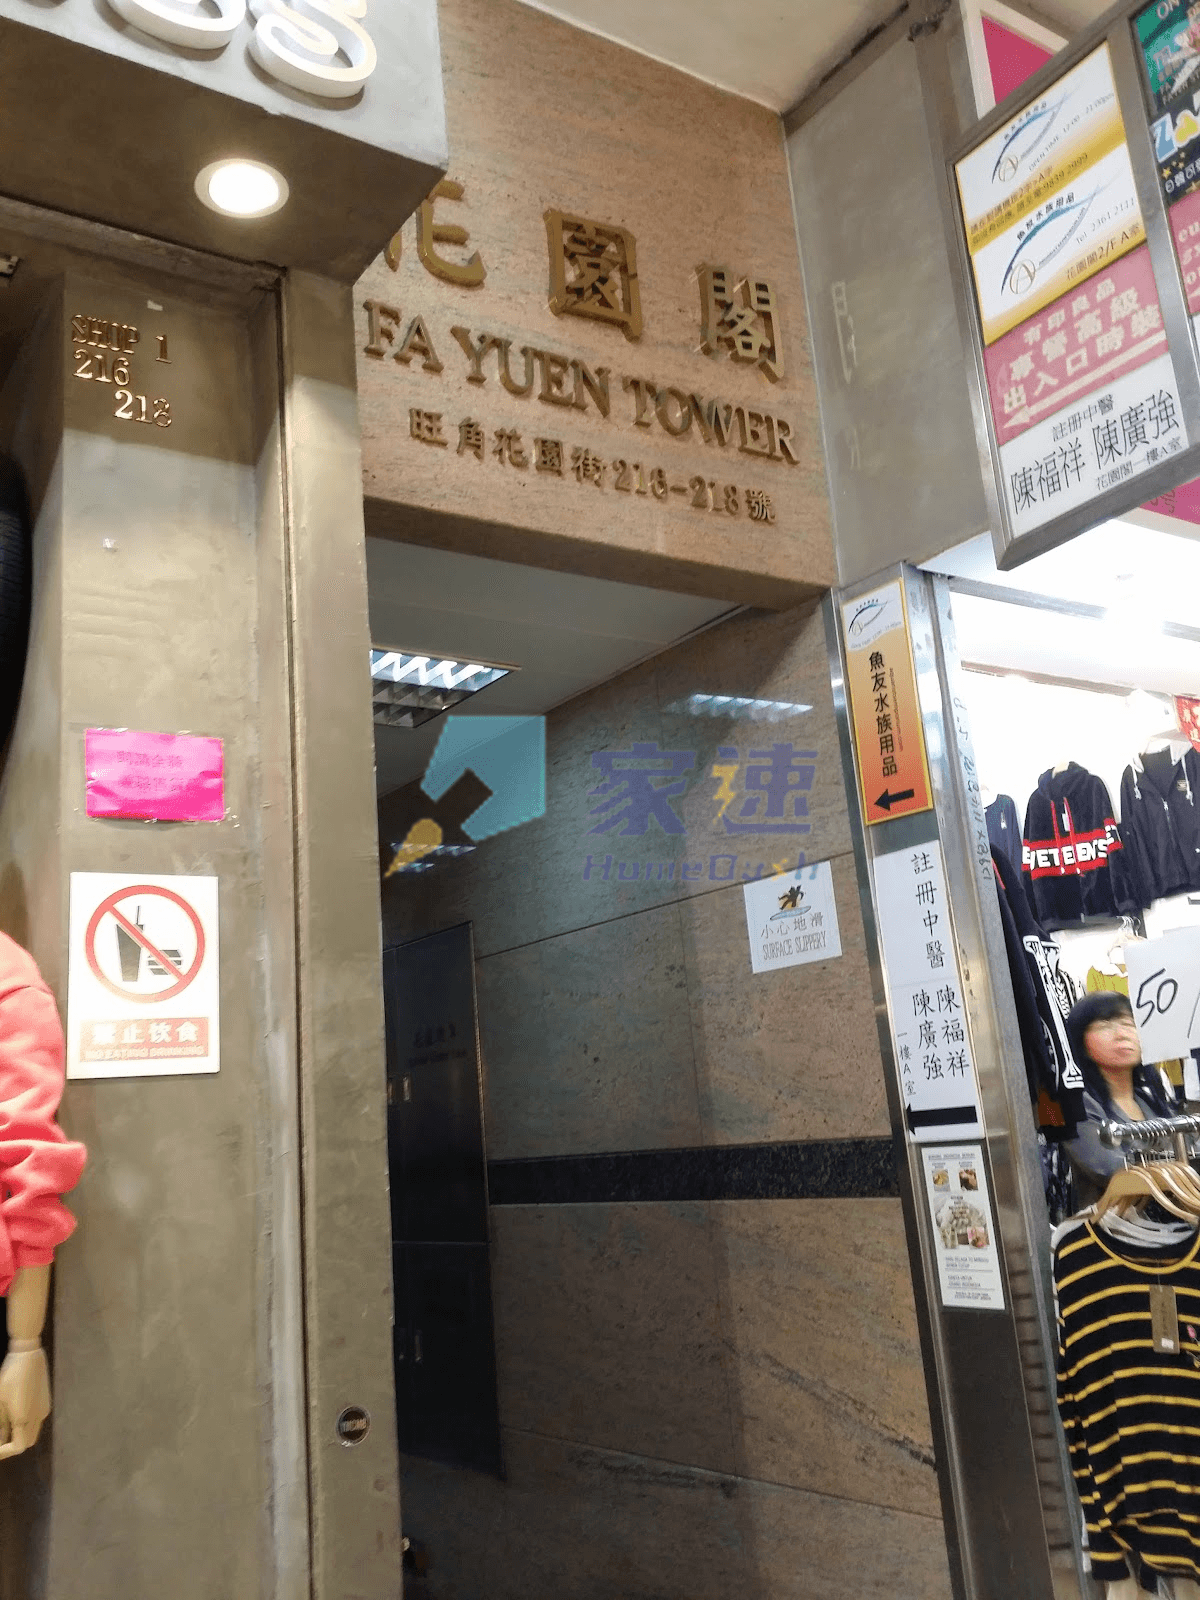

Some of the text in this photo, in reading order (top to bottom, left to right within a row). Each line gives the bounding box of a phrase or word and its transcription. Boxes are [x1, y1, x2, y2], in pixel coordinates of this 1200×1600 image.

[72, 314, 172, 364] SHOP 1
[72, 348, 130, 386] 216
[113, 389, 172, 427] 218
[363, 299, 800, 465] FA YUEN TOWER
[1010, 389, 1180, 515] 陳福祥 陳廣強
[868, 651, 898, 778] 魚友水族用品
[761, 912, 824, 939] 小心地滑
[762, 931, 827, 961] SURFACE SLIPPERY
[911, 852, 946, 969] 註冊中醫
[897, 1031, 917, 1097] 一樓A室
[912, 989, 945, 1081] 陳廣強
[936, 984, 970, 1078] 陳福祥
